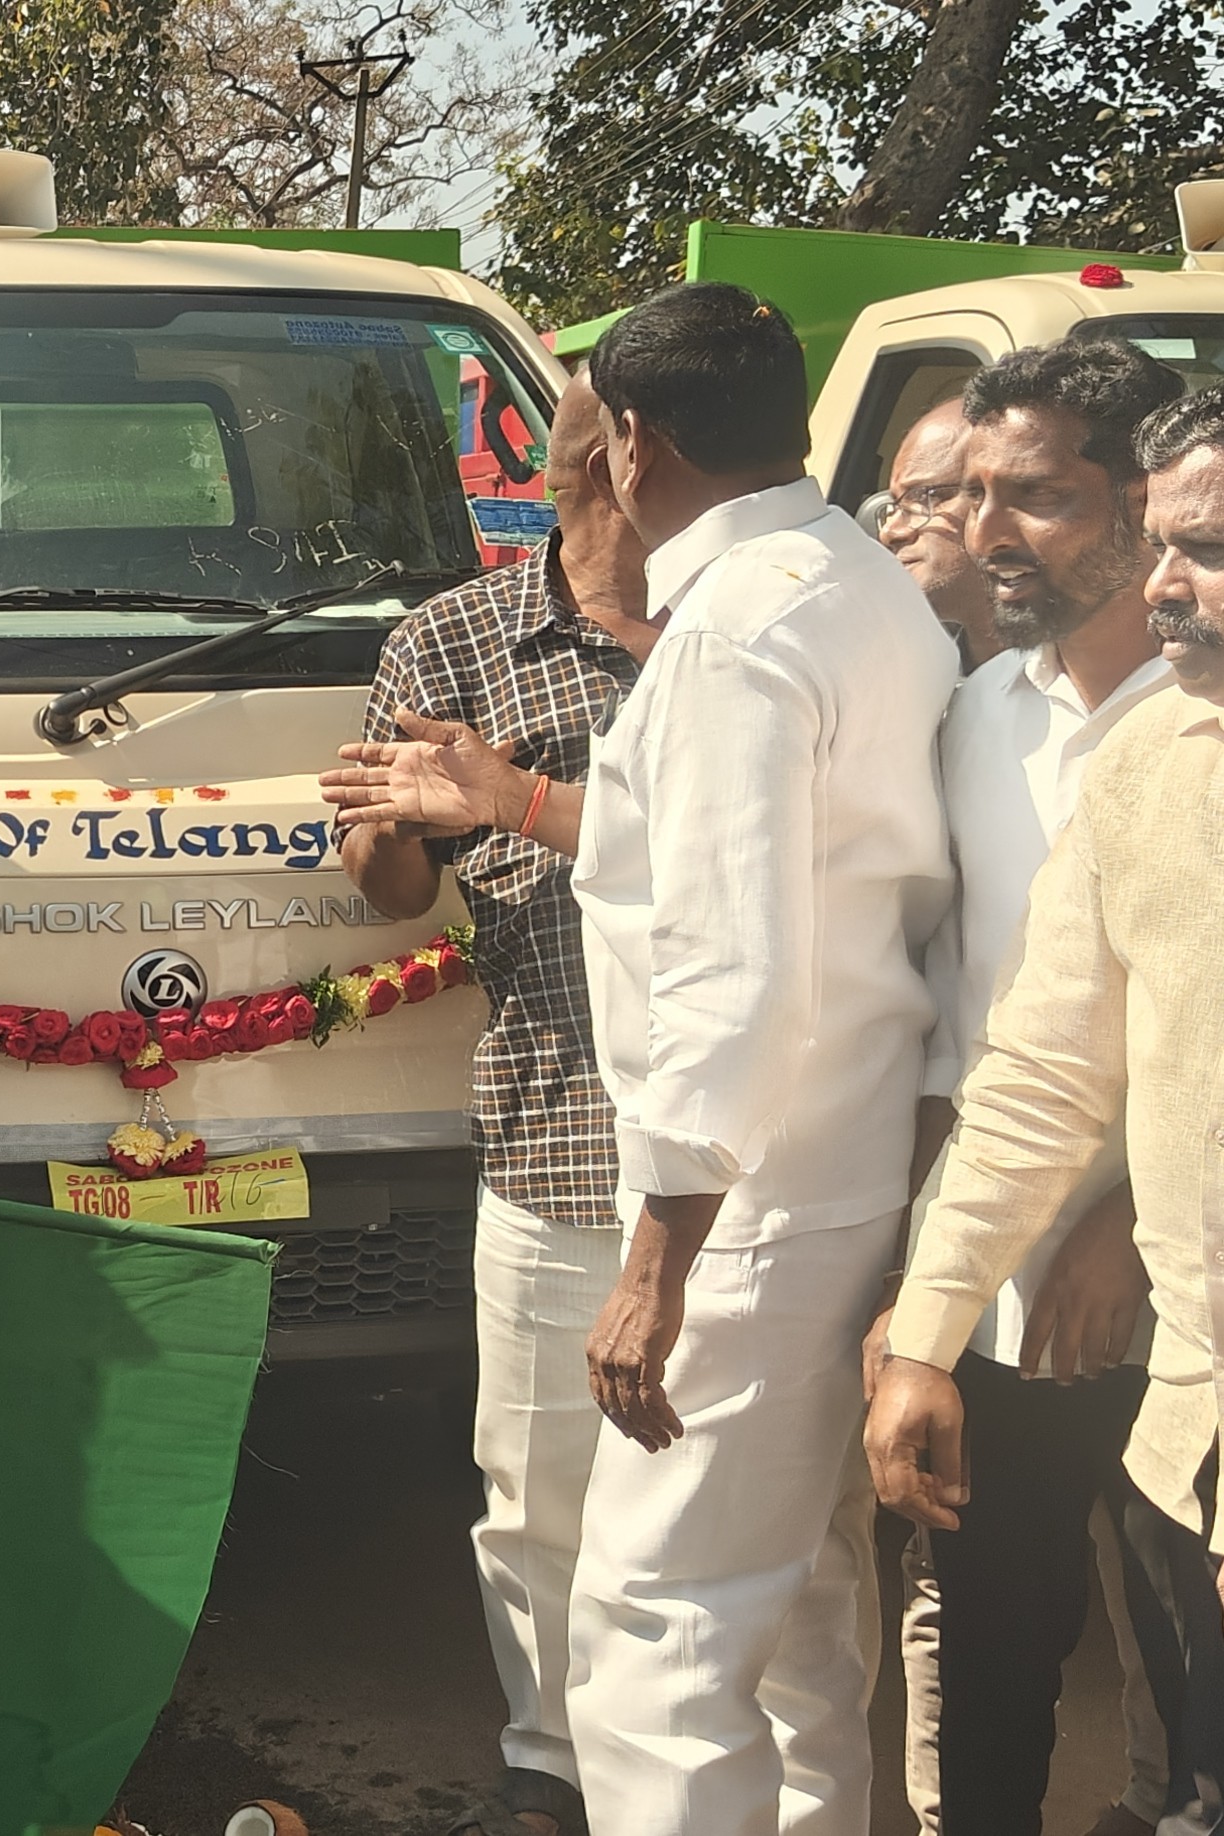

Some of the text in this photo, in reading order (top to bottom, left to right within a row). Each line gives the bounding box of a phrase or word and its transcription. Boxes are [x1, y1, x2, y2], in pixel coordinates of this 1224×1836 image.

[72, 807, 330, 869] Telang
[153, 978, 181, 1000] L
[66, 1157, 294, 1186] SABO OZONE
